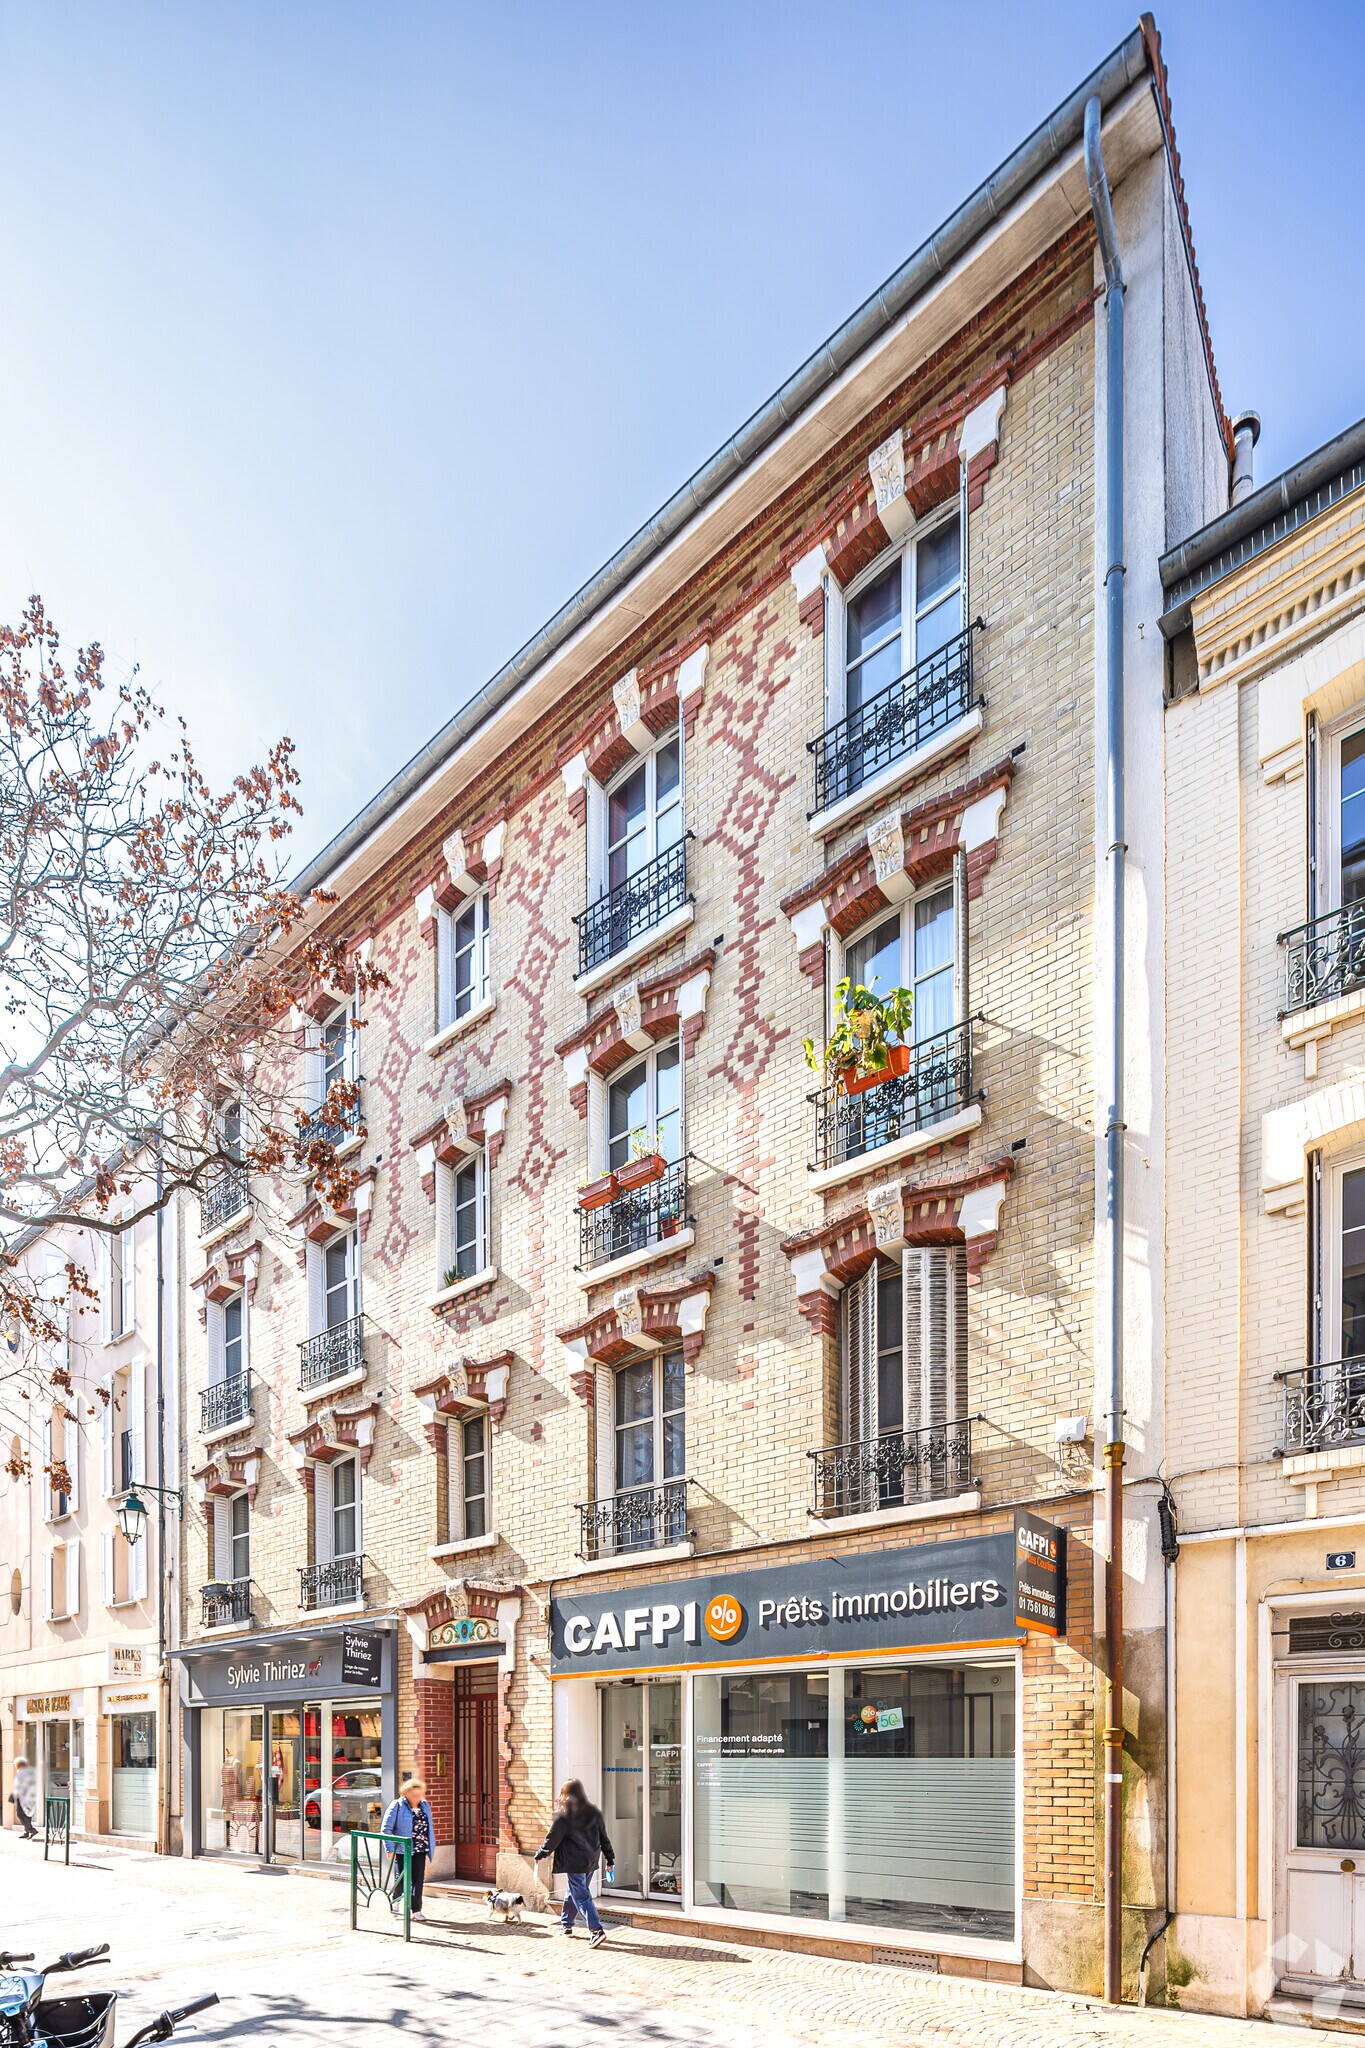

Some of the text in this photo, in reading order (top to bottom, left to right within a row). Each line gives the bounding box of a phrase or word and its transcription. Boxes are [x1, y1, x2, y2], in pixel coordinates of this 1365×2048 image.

[1018, 1526, 1049, 1556] CAFPI
[1028, 1553, 1037, 1565] des
[1037, 1557, 1057, 1573] Courtiers
[1335, 1555, 1347, 1567] 6
[1018, 1581, 1056, 1603] Prêts immobiliers
[1018, 1596, 1056, 1619] 01 75 61 88 88
[564, 1600, 696, 1653] CAFPI
[759, 1597, 823, 1626] Prêts
[832, 1578, 1000, 1618] immobiliers
[345, 1635, 369, 1648] Sylvie
[113, 1648, 142, 1662] MARKS
[345, 1647, 372, 1660] Thiriez
[227, 1659, 306, 1689] Sylvie Thiriez
[880, 1713, 898, 1728] 50
[696, 1734, 783, 1744] Financement adapté
[655, 1750, 679, 1758] CAFPI
